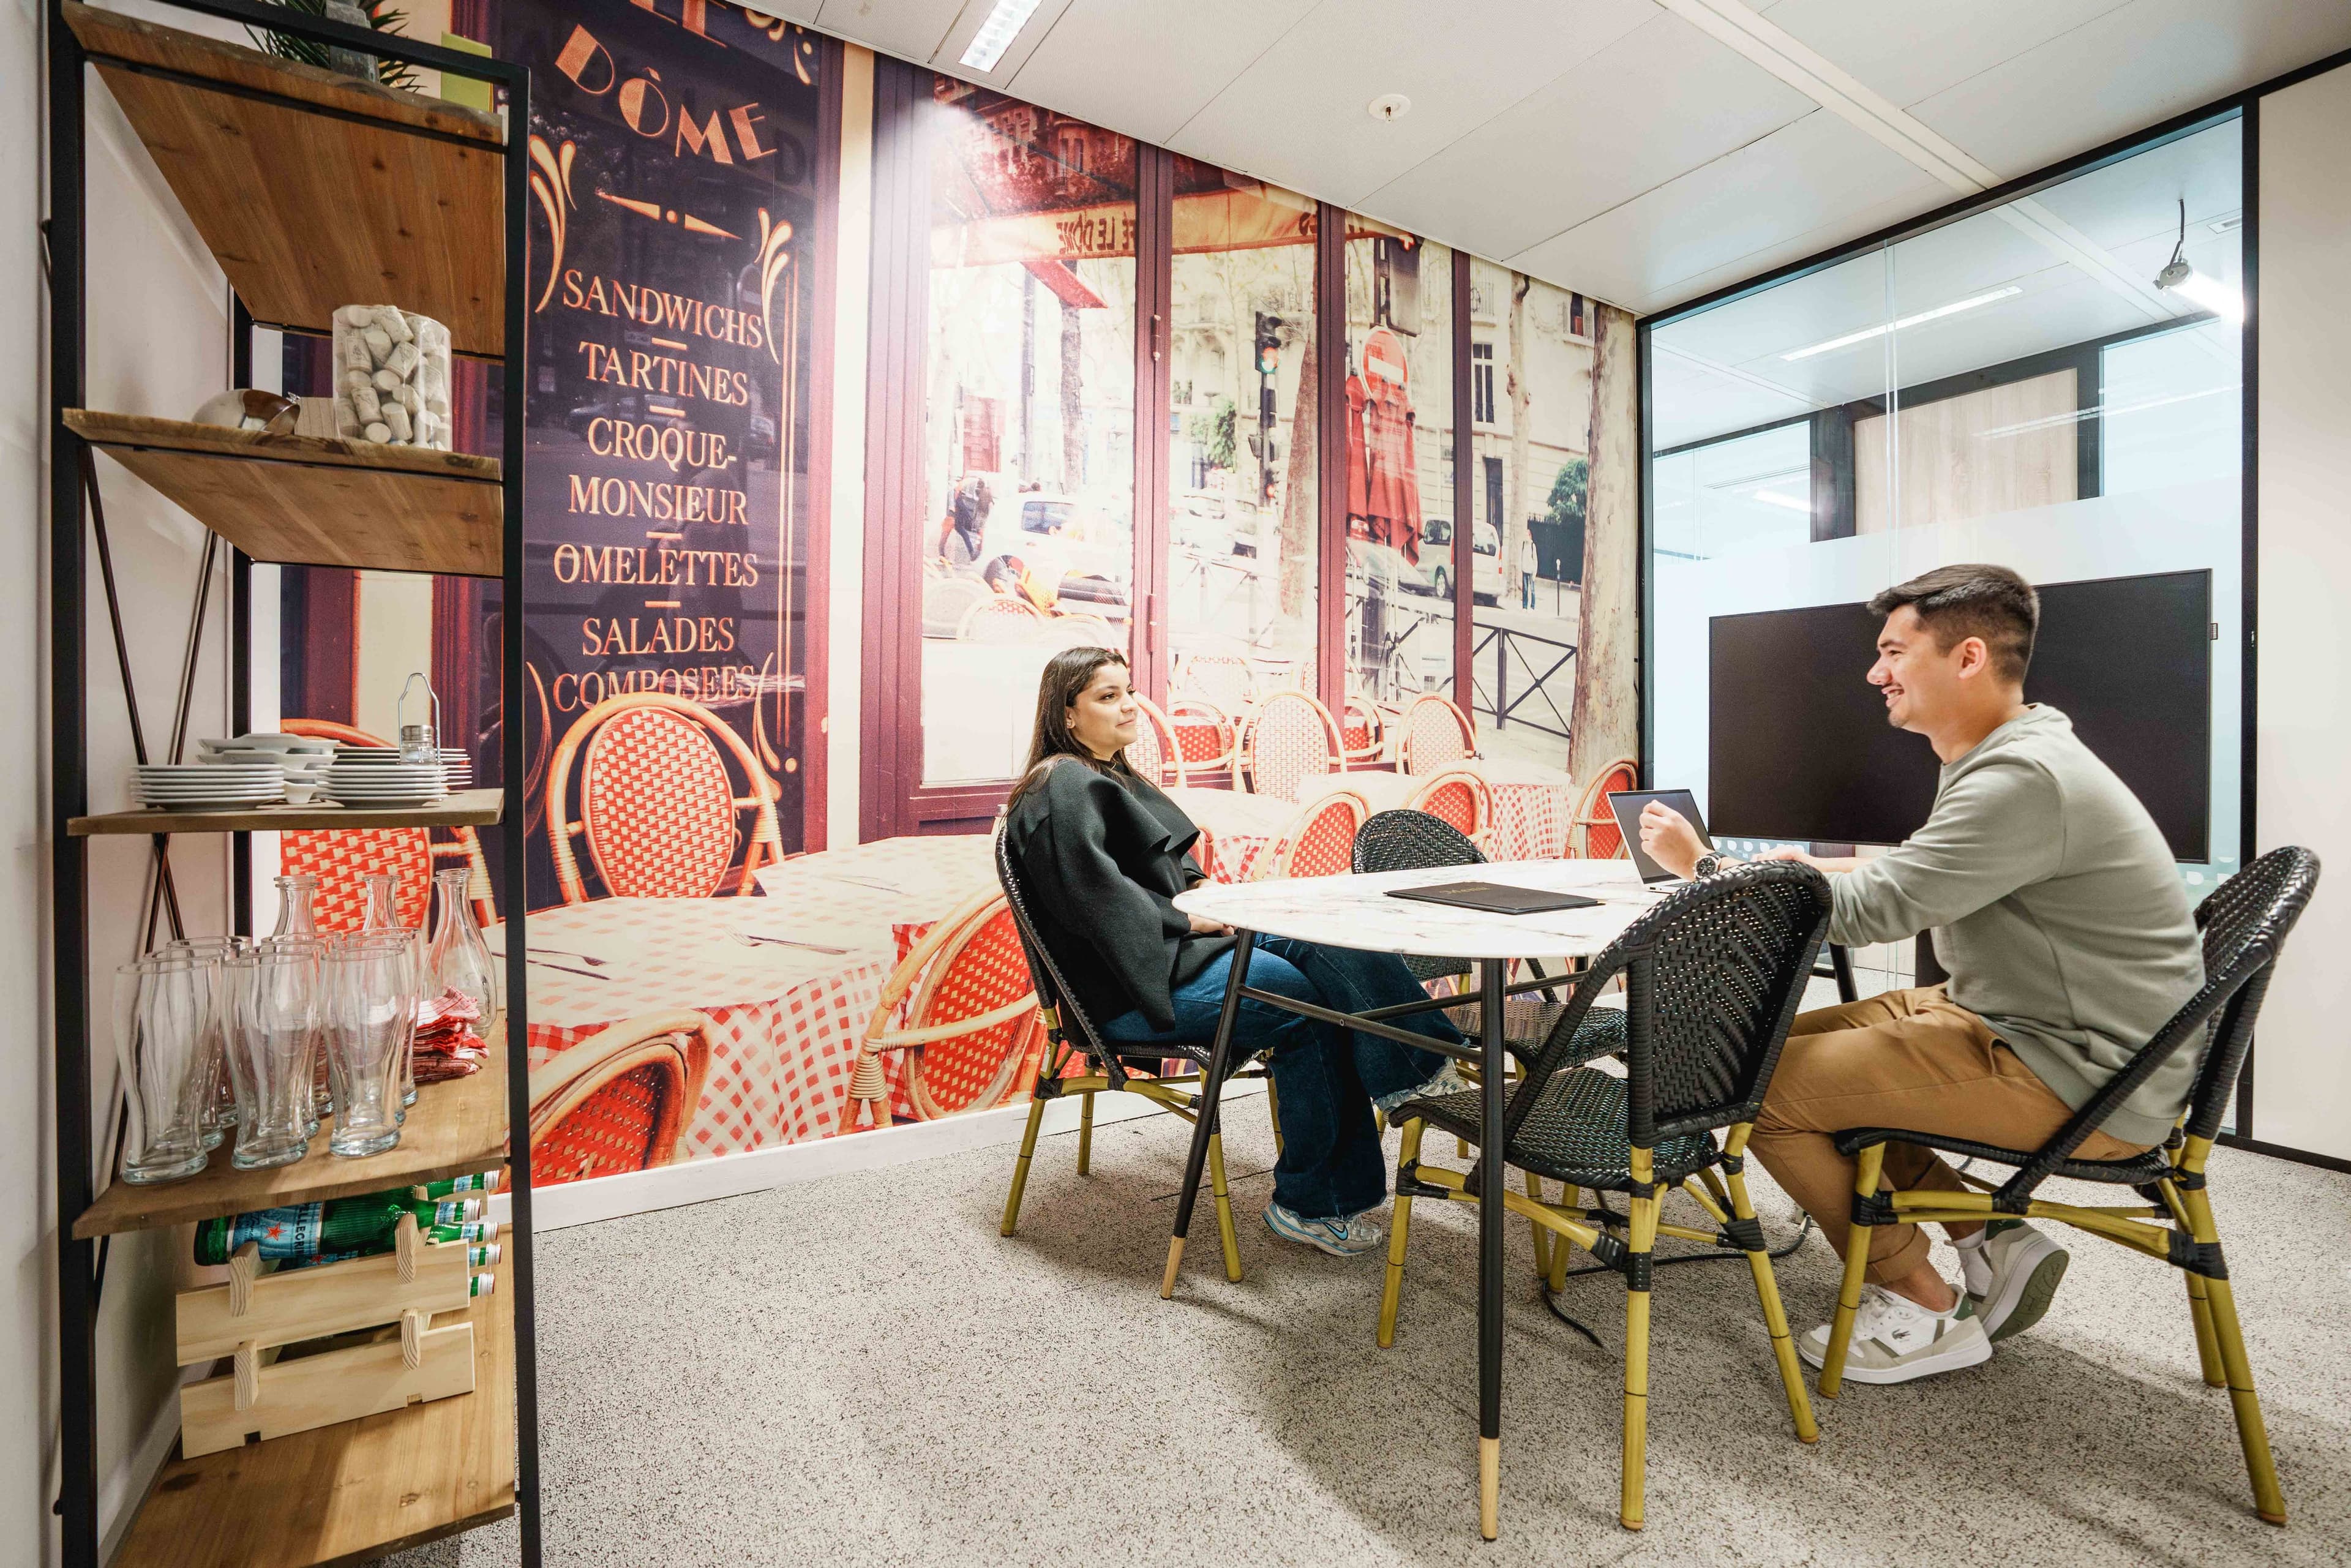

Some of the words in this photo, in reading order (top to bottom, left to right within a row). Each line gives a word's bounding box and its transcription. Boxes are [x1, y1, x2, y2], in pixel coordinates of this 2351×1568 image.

[554, 23, 778, 165] DÔME
[563, 269, 764, 348] SANDWICHS
[578, 340, 748, 406] TARTINES
[588, 416, 737, 472] CROQUE-
[568, 474, 749, 525] MONSIEUR
[553, 544, 759, 587] OMELETTES
[582, 617, 734, 656] SALADES
